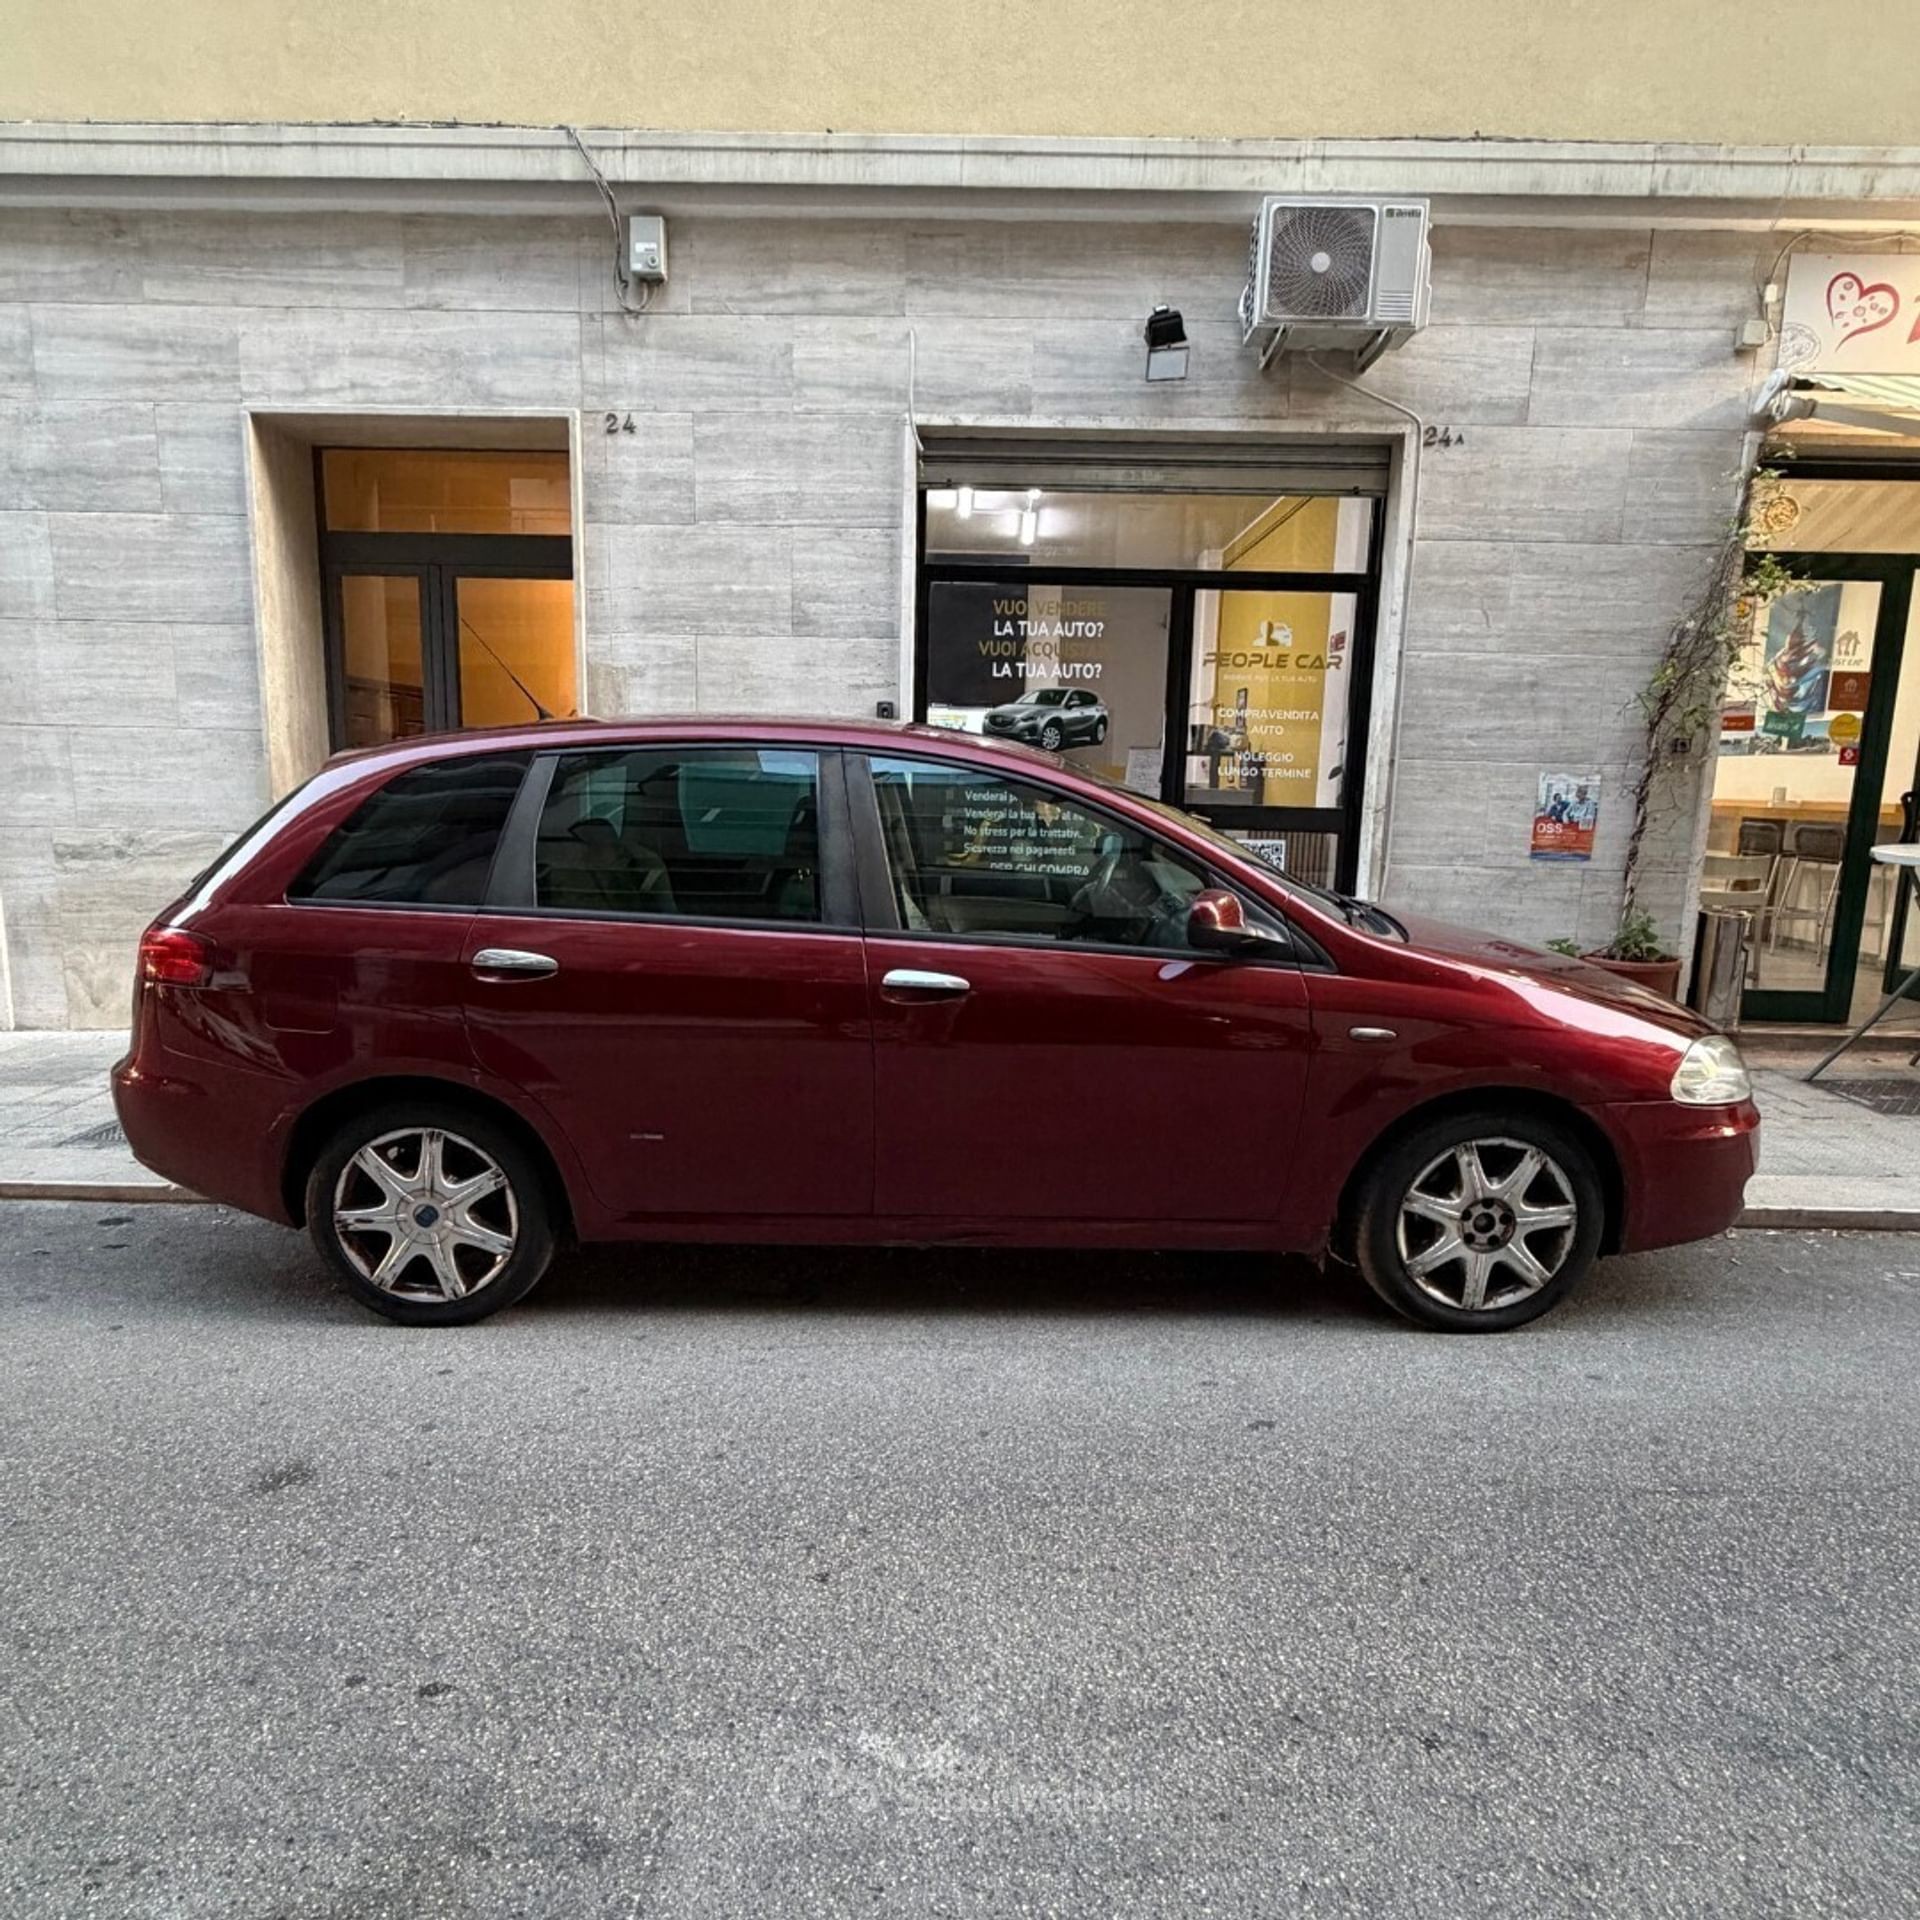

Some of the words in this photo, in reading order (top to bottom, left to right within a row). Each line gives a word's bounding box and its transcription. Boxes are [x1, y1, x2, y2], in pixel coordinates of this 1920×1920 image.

[605, 412, 637, 434] 24
[993, 600, 1031, 616] VUO
[1036, 600, 1107, 617] VENDERE
[994, 620, 1014, 636] LA
[1018, 621, 1050, 637] TUA
[1052, 621, 1105, 638] AUTO?
[979, 640, 1016, 657] VUOI
[1202, 652, 1290, 668] PEOPLE
[1295, 654, 1343, 669] CAR
[992, 662, 1013, 678] LA
[1016, 663, 1050, 678] TUA
[1051, 663, 1103, 679] AUTO?
[1218, 708, 1319, 721] COMPRAVENDITA
[1251, 725, 1285, 735] AUTO
[1235, 752, 1294, 763] NOLEGGIO
[1218, 767, 1258, 777] LUNGO
[1261, 768, 1312, 779] TERMINE
[965, 790, 1007, 801] Venderai
[965, 807, 1007, 819] Venderai
[1008, 809, 1018, 819] la
[1021, 810, 1035, 820] tua
[964, 826, 977, 836] No
[979, 826, 1008, 837] stress
[1010, 828, 1025, 838] per
[1028, 826, 1037, 837] la
[1536, 823, 1563, 833] OSS
[964, 842, 1007, 854] Sicurezza
[1010, 844, 1024, 854] nei
[1026, 845, 1076, 858] pagamenti
[1038, 864, 1090, 876] COMPRA
